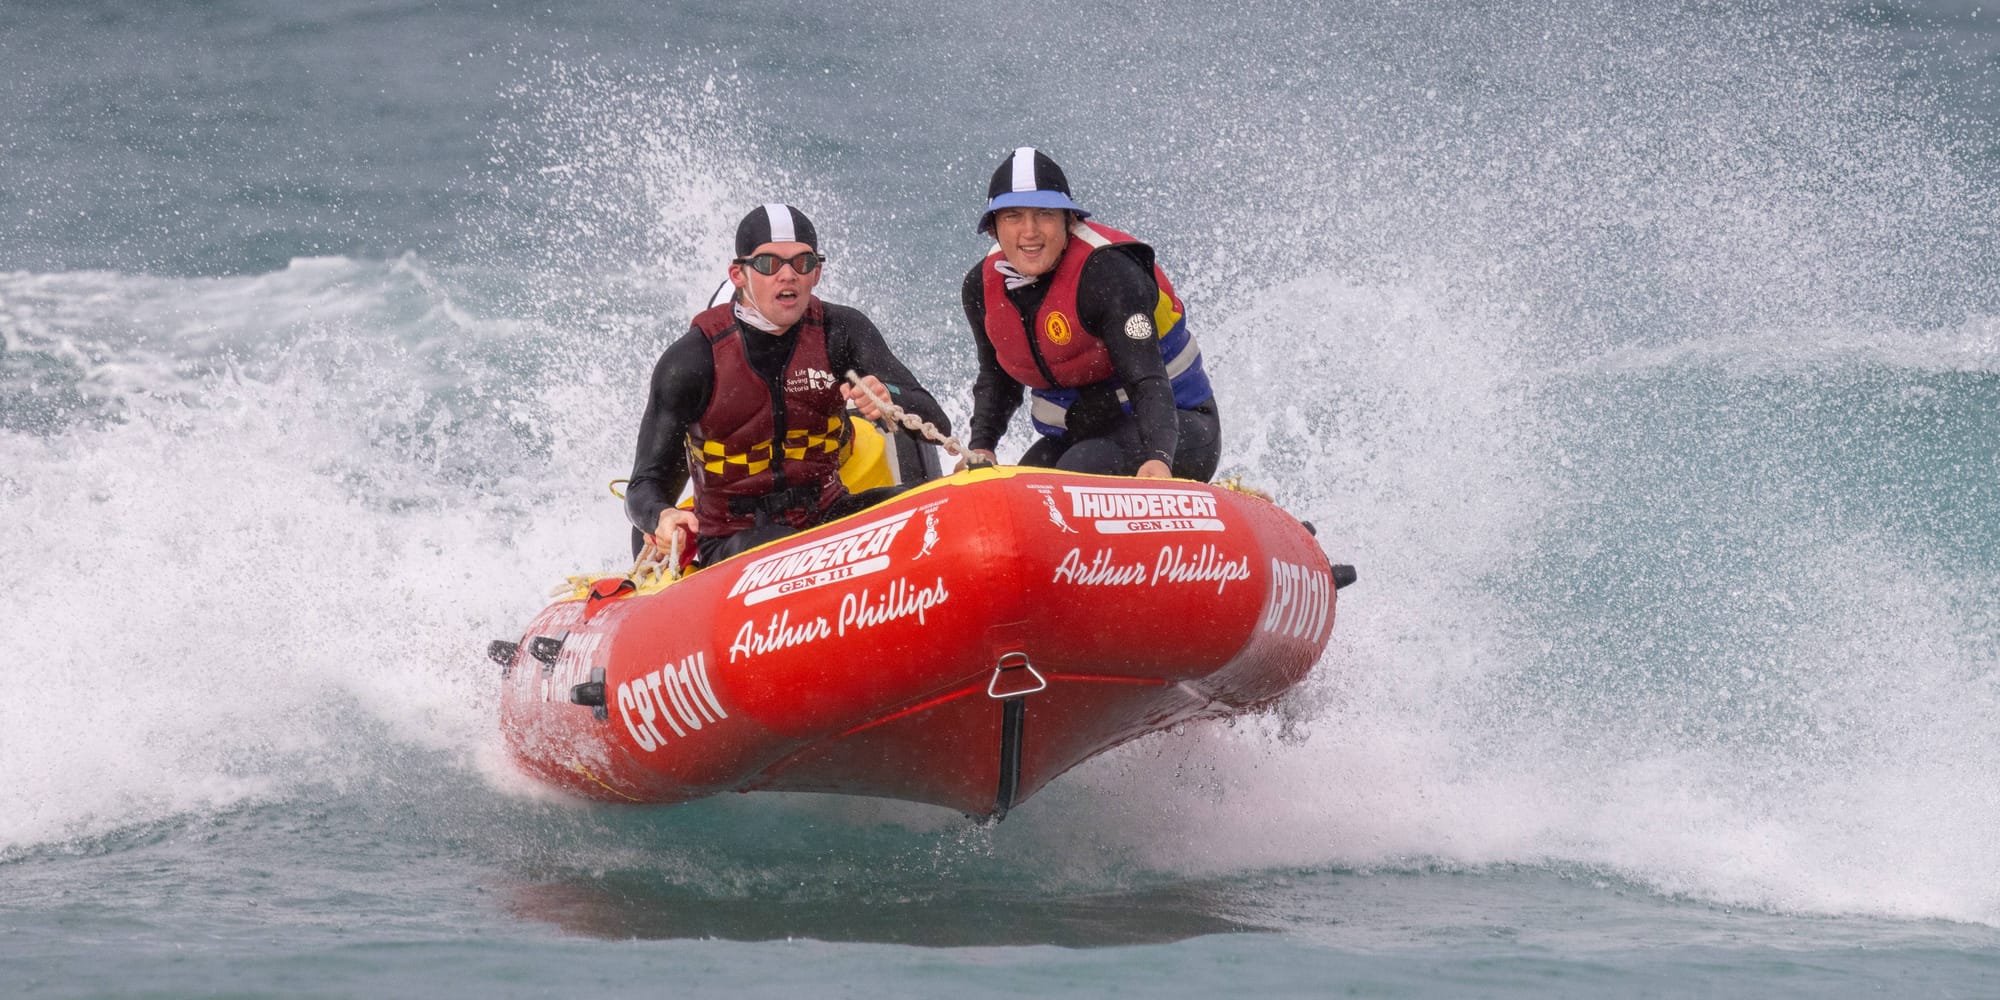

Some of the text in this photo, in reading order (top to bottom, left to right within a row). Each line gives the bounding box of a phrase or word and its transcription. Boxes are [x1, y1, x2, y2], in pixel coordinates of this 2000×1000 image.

[786, 378, 808, 386] Saving
[795, 369, 806, 377] Life
[1063, 485, 1217, 518] THUNDERCAT
[727, 507, 917, 600] THUNDERCAT
[1052, 544, 1250, 595] Arthur Phillips
[729, 576, 949, 664] Arthur Phillips
